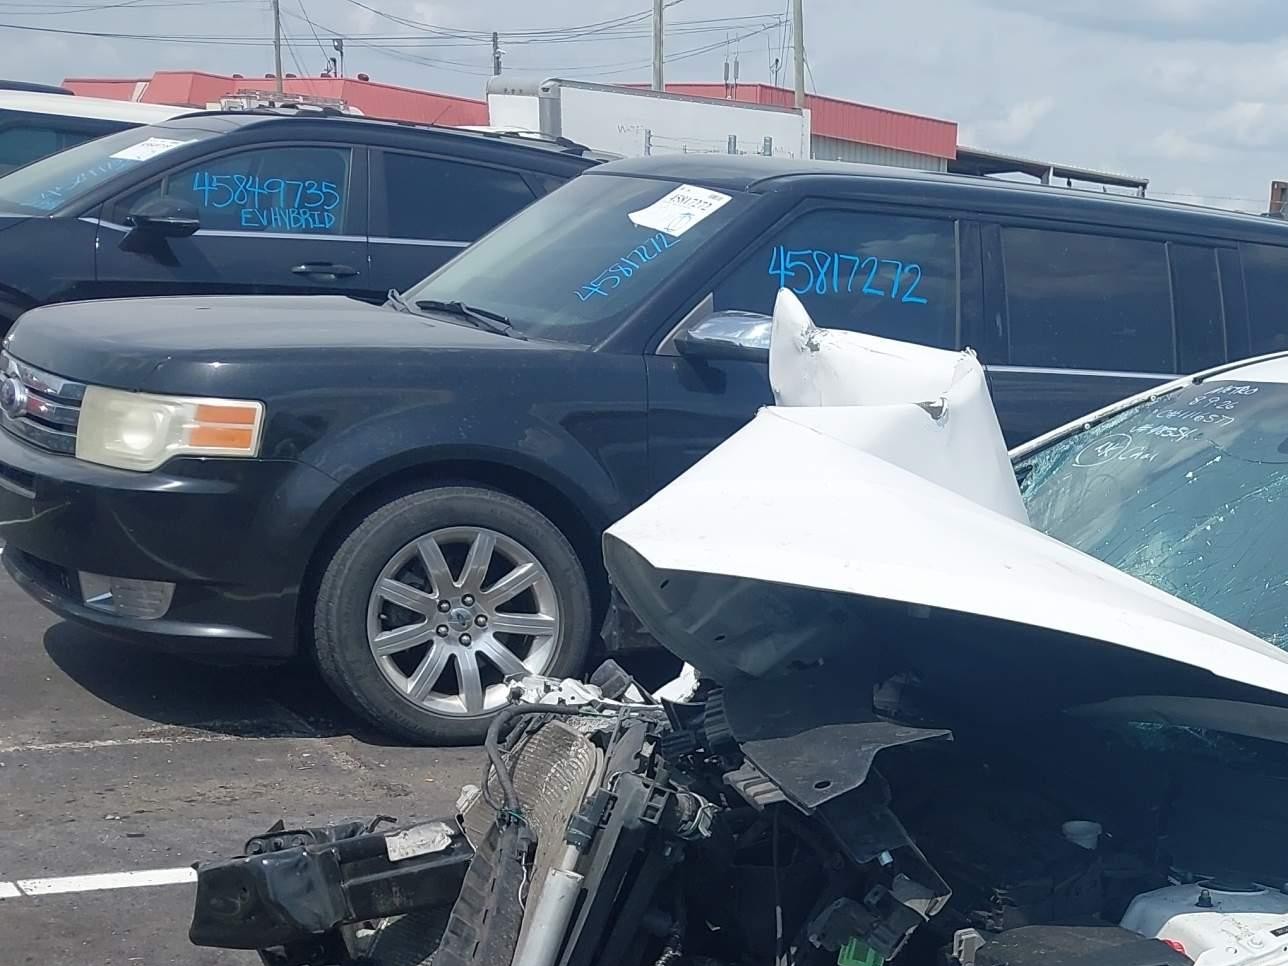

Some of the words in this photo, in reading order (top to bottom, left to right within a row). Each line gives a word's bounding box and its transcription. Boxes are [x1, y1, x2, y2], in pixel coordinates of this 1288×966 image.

[192, 171, 340, 210] 45849735
[573, 231, 681, 301] 45817272
[769, 245, 927, 304] 45817272
